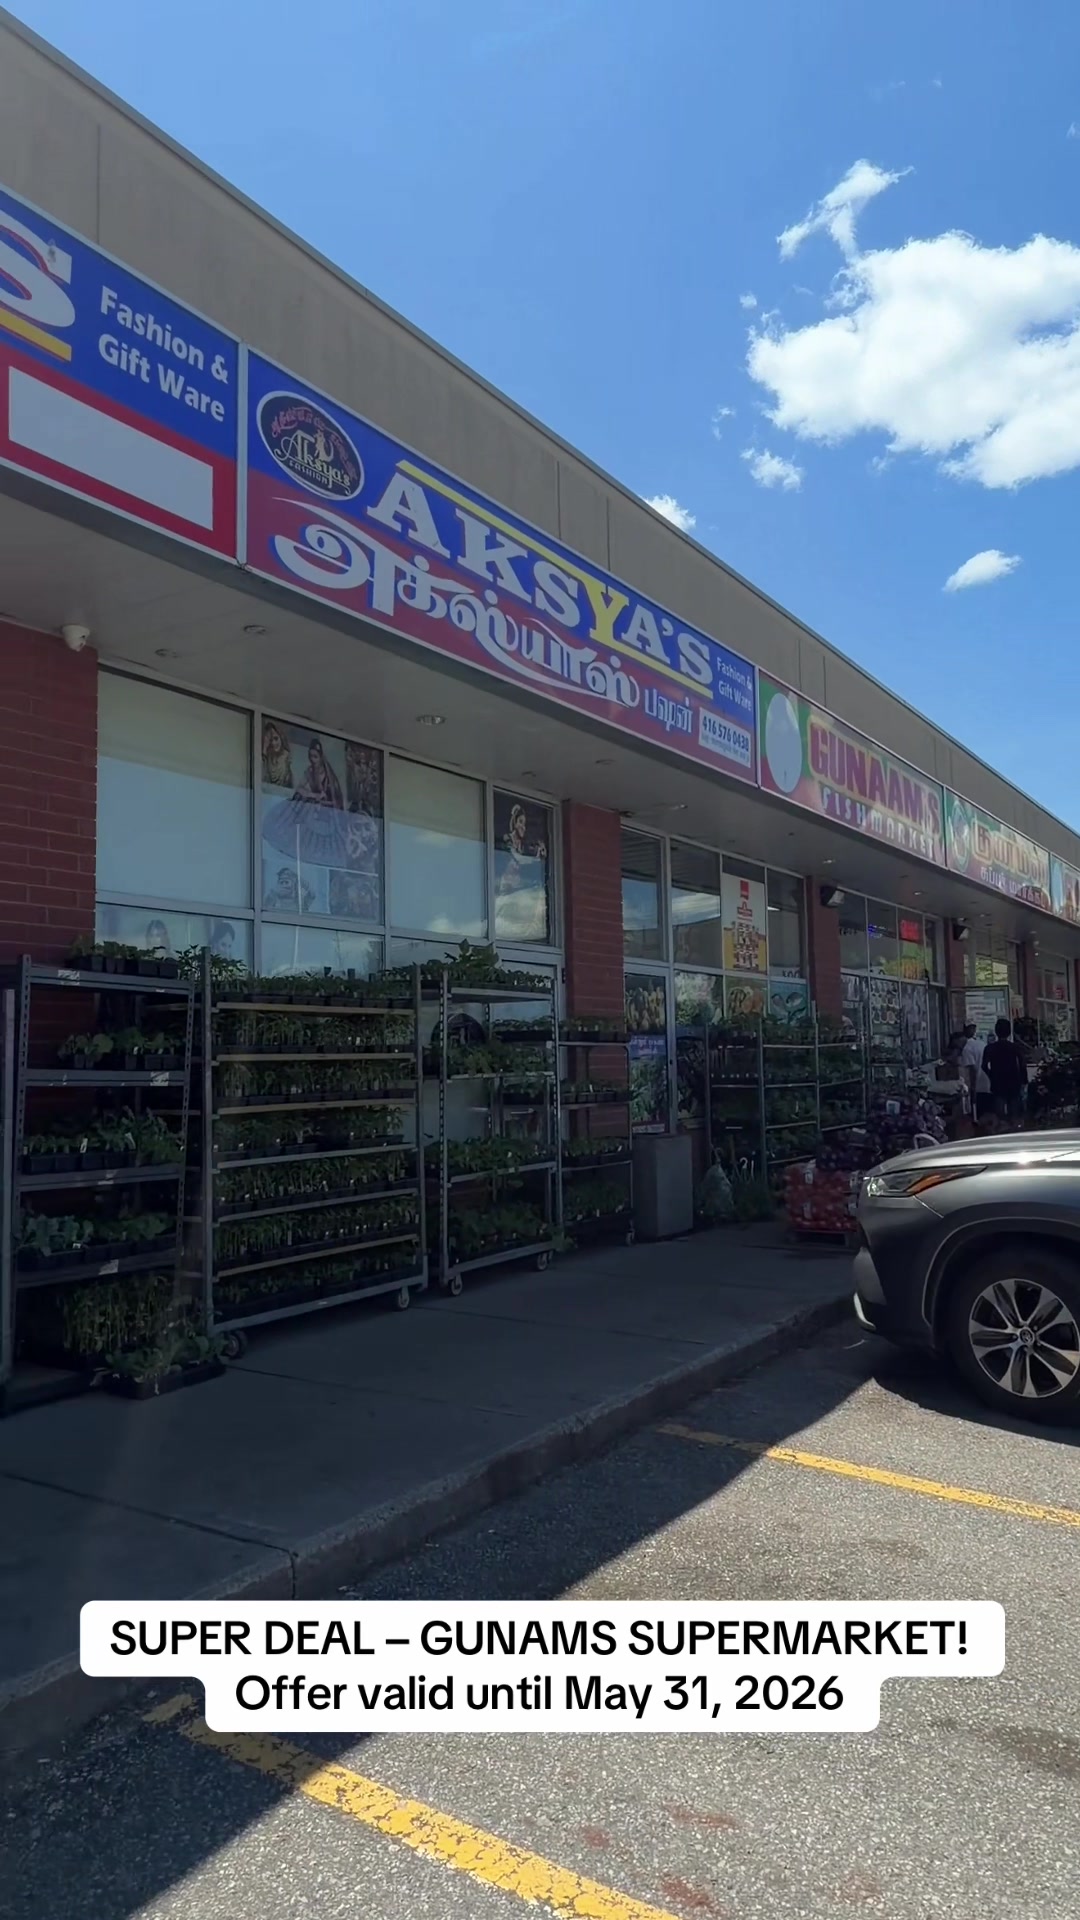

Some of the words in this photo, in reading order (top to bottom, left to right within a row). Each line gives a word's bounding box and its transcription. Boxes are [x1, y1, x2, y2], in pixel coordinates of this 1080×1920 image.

[100, 285, 204, 371] Fashion
[211, 354, 229, 384] &
[98, 333, 150, 384] Gift
[158, 361, 225, 423] Ware
[274, 429, 352, 496] Aksya's
[366, 461, 714, 699] AKSYA'S
[716, 656, 747, 688] Fashion
[746, 674, 753, 691] &
[718, 679, 734, 703] Gift
[733, 689, 752, 712] Ware
[702, 715, 717, 736] 416
[718, 723, 732, 743] 576
